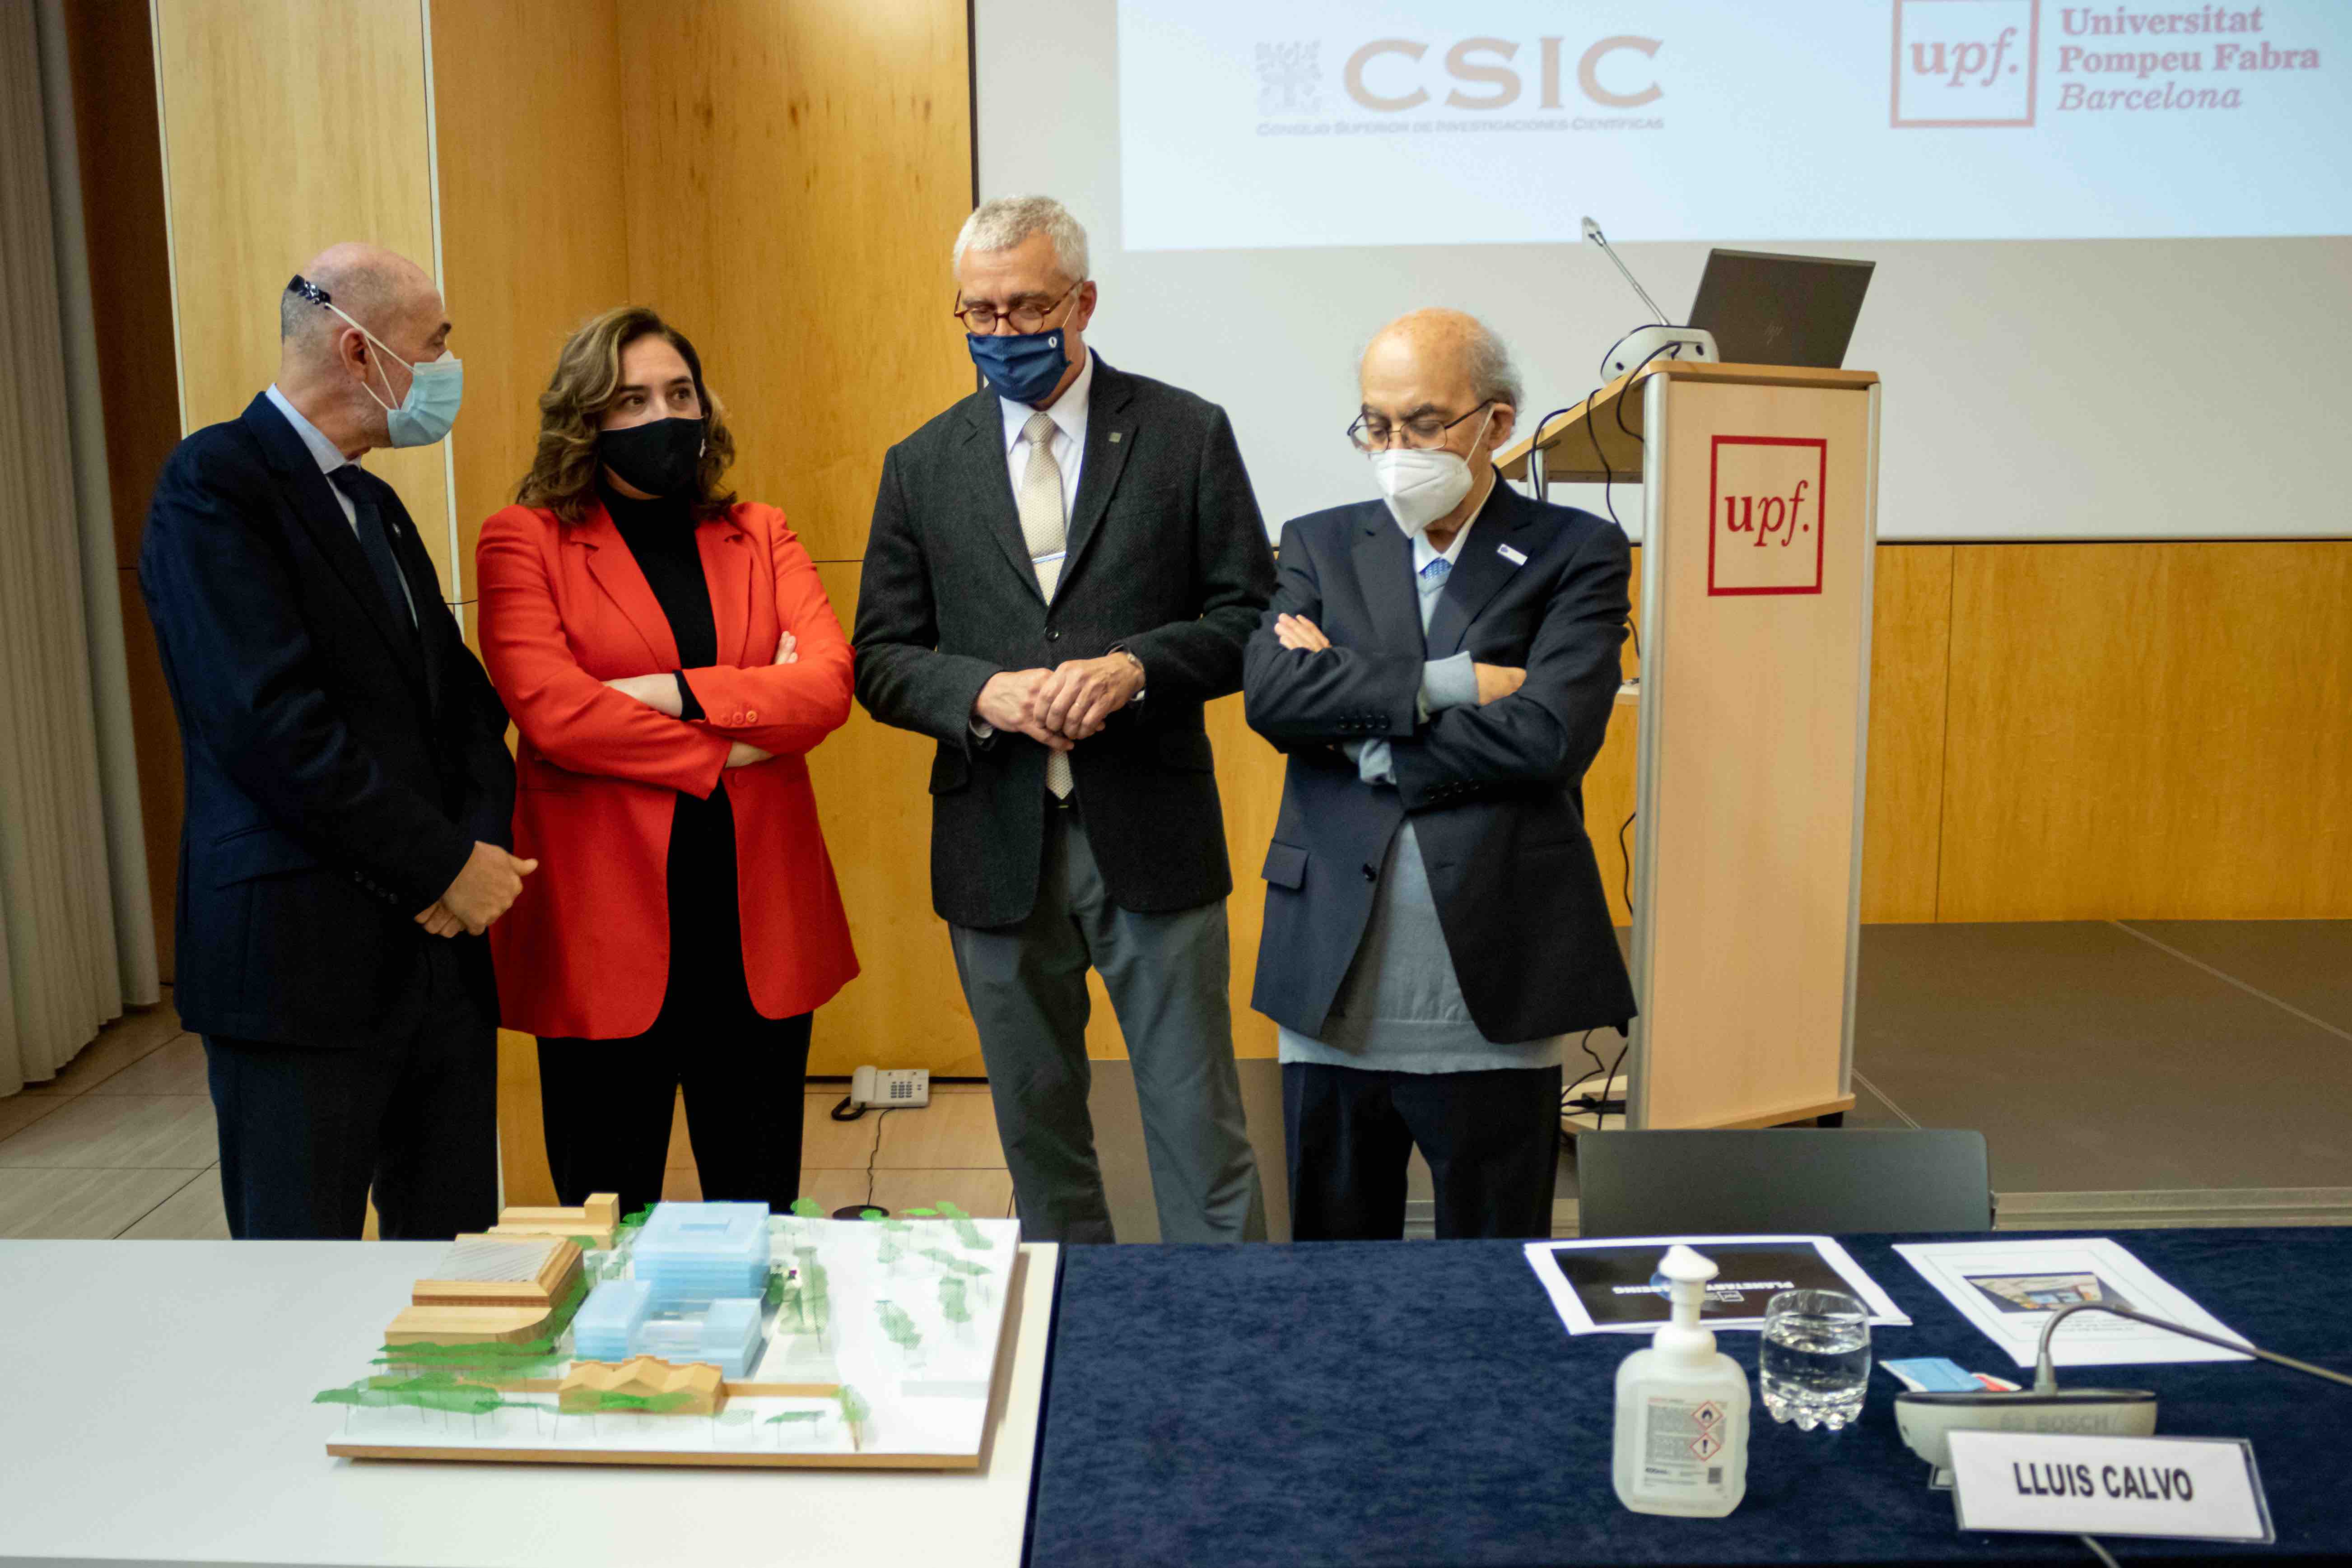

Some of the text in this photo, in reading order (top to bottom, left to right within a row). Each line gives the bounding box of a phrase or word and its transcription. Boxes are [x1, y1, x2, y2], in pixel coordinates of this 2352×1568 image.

[2060, 5, 2264, 36] Universitat
[1344, 35, 1664, 112] CSIC
[2057, 41, 2321, 78] Pompeu Fabra
[2056, 82, 2243, 112] Barcelona
[1724, 479, 1809, 547] upf.
[2037, 1414, 2109, 1432] BOSCH
[2013, 1462, 2194, 1501] LLUIS CALVO
